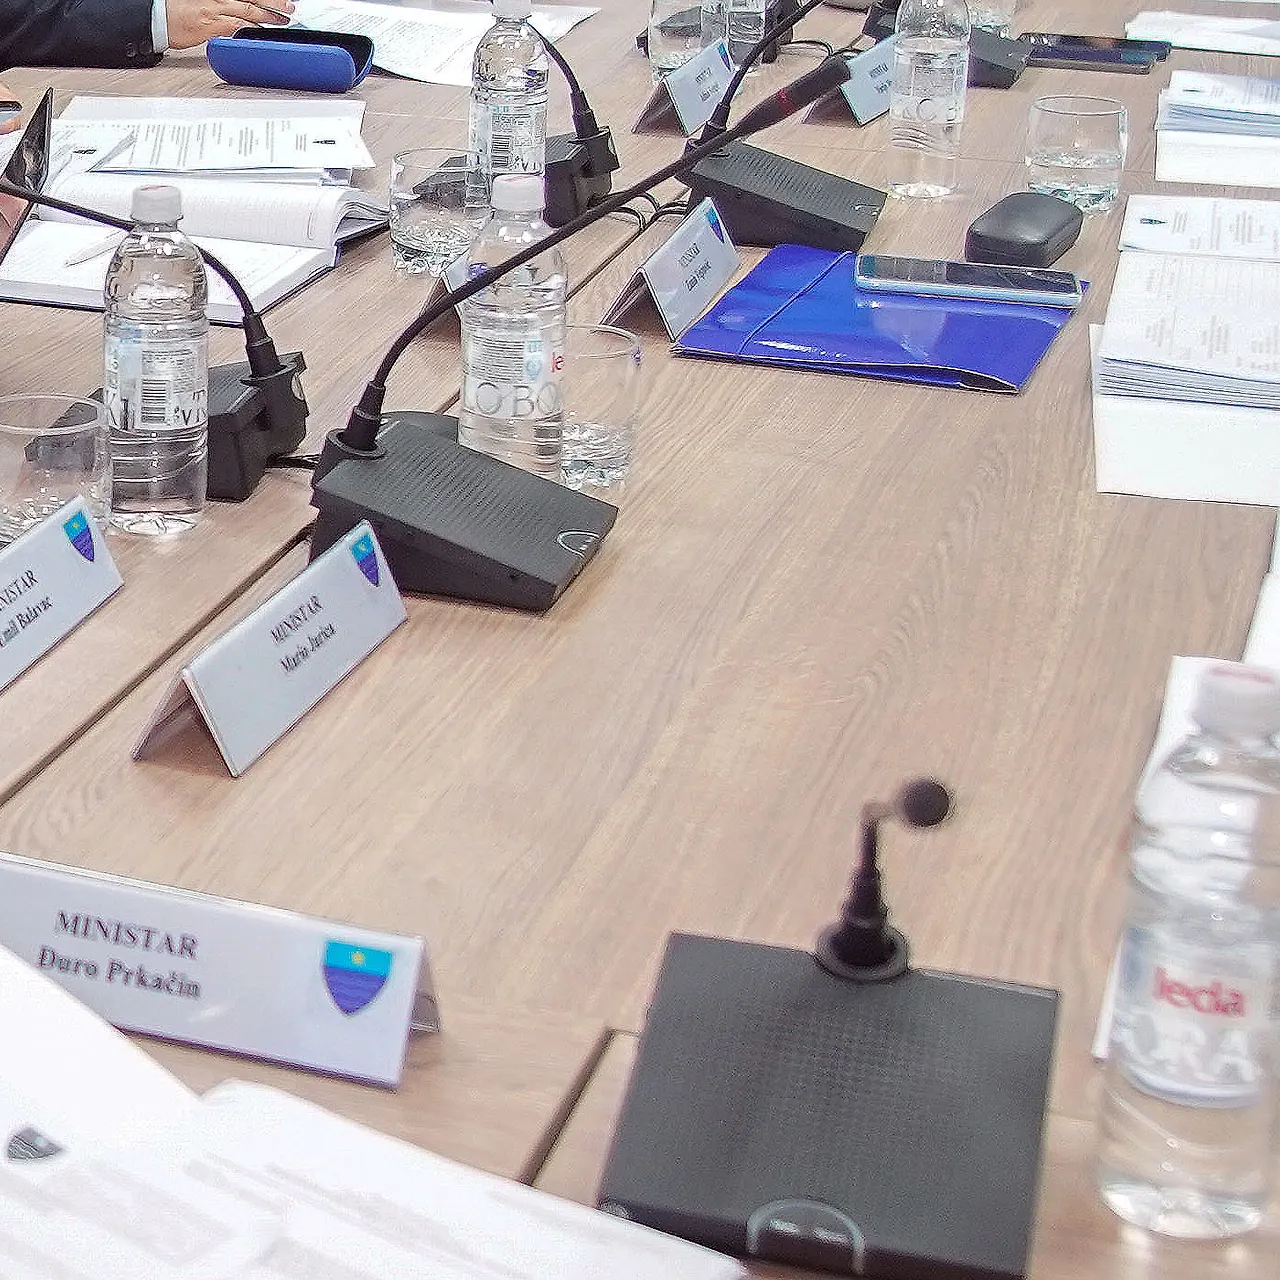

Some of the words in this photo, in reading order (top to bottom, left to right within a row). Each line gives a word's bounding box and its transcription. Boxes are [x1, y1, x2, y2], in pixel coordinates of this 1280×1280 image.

[55, 909, 198, 960] MINISTAR
[106, 958, 202, 999] Prkačin
[1153, 965, 1246, 1018] leda
